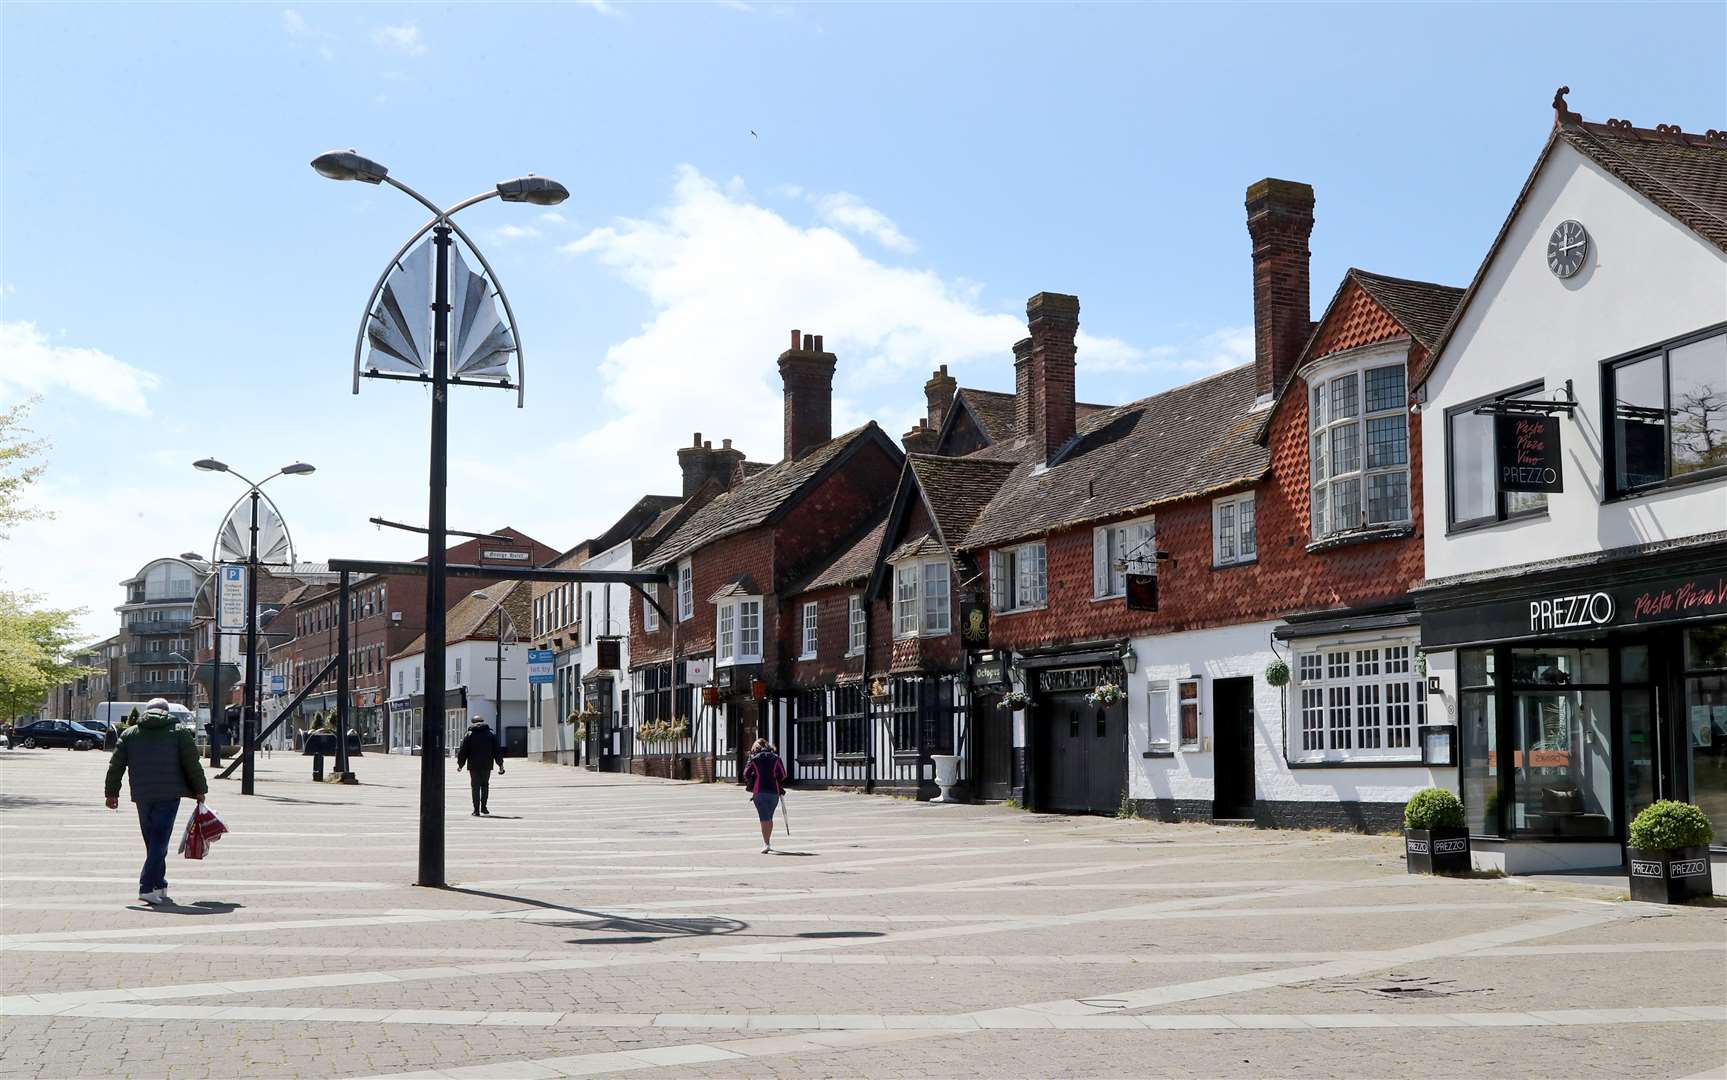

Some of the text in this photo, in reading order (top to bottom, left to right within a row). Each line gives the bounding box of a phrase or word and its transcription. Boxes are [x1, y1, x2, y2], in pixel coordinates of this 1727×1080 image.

[1516, 420, 1544, 433] Pasta
[1517, 434, 1544, 448] Pizza
[1517, 450, 1544, 464] Vino
[1504, 467, 1556, 483] PREZZO
[1530, 578, 1727, 631] PREZZO Pasta Pizza V
[976, 668, 1000, 679] Octopus
[1408, 841, 1427, 851] PREZZO
[1436, 841, 1465, 851] PREZZO
[1633, 863, 1661, 874] PREZZO
[1672, 862, 1704, 875] PREZZO
